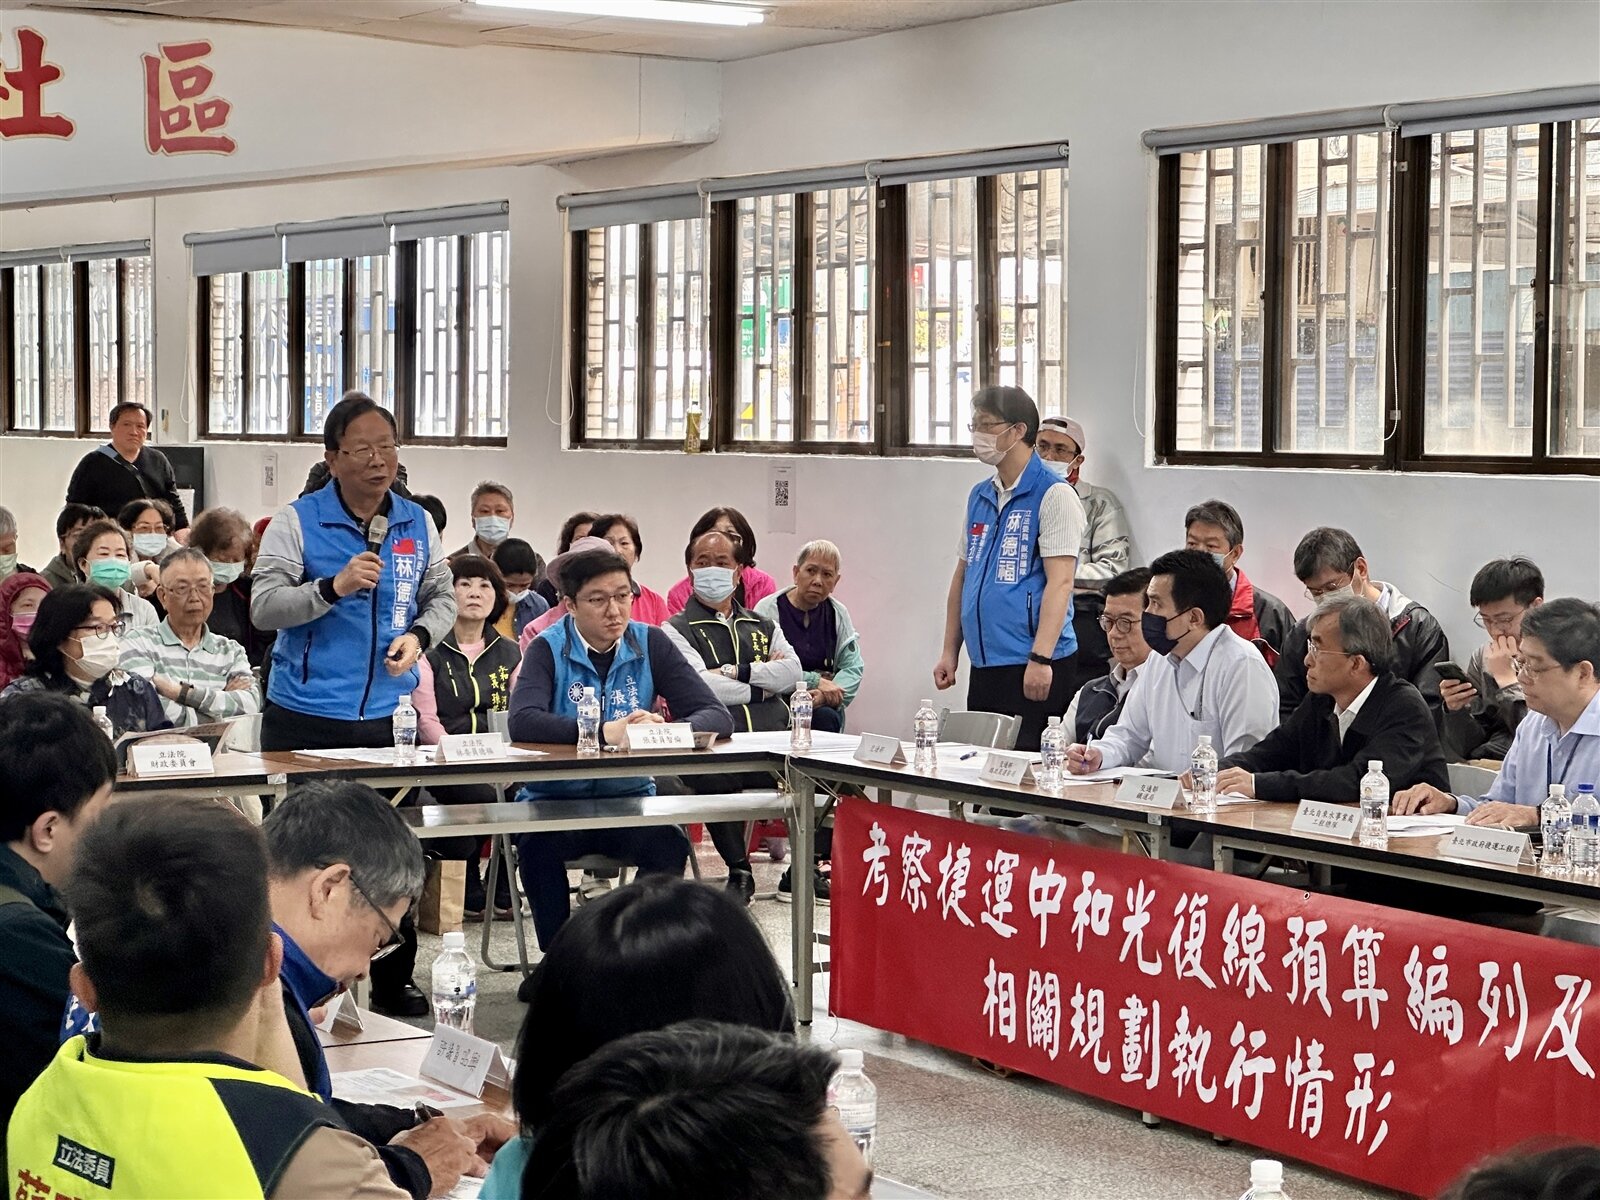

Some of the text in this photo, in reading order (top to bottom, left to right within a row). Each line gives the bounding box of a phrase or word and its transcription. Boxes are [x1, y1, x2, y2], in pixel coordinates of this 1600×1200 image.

[1020, 510, 1032, 541] 立法委員
[997, 513, 1022, 582] 林德福
[393, 556, 414, 628] 林德福
[625, 675, 640, 713] 立法委
[462, 739, 485, 748] 立法院
[646, 728, 673, 736] 立法院
[150, 759, 197, 769] 財政委員會
[158, 750, 187, 759] 立法院
[1140, 784, 1159, 793] 交通部
[1302, 806, 1355, 824] 臺北自來水事業處
[1451, 836, 1521, 855] 臺北市政府捷運工程局
[862, 821, 1596, 1079] 考察捷運中和光復線預算編列及
[982, 957, 1395, 1156] 相關規劃執行情形
[57, 1142, 110, 1184] 立法委員
